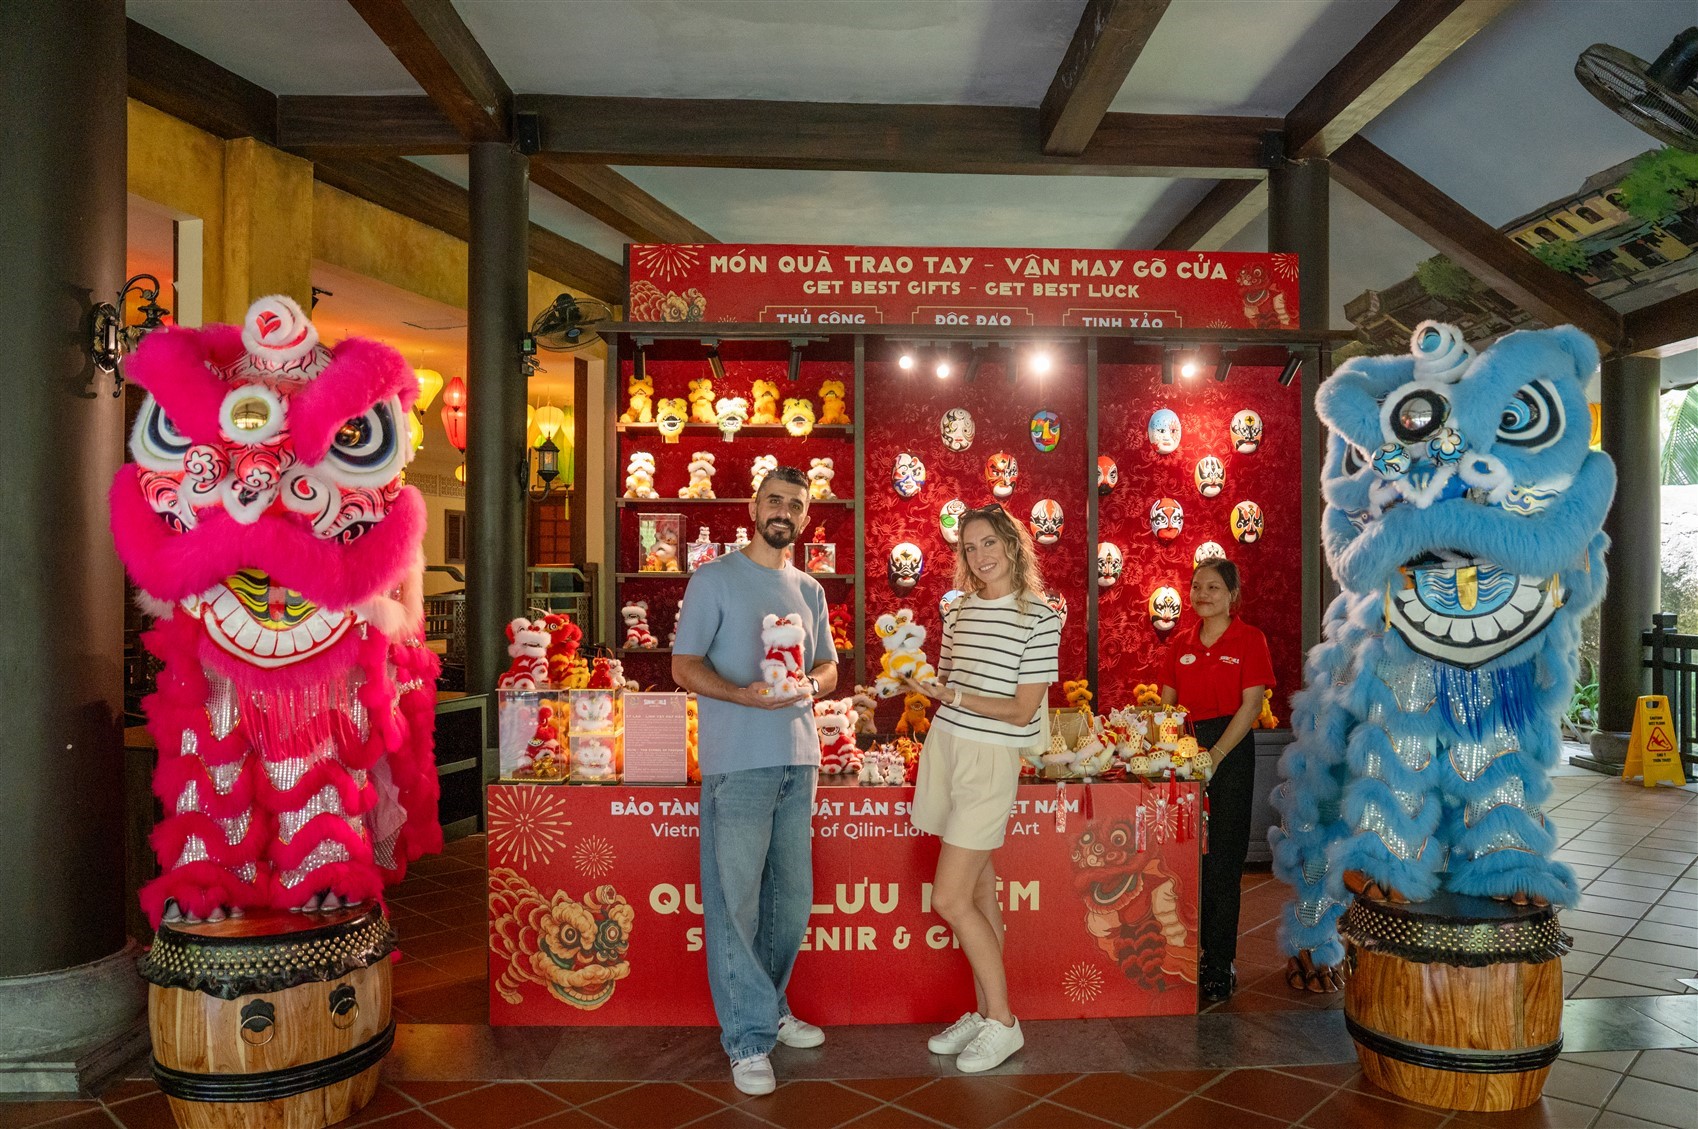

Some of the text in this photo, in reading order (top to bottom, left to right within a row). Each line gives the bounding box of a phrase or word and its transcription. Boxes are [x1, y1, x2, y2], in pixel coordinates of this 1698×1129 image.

[710, 248, 767, 273] MÓN
[778, 250, 833, 273] QUÀ
[844, 256, 913, 274] TRAO
[923, 256, 974, 274] TAY
[1071, 259, 1124, 277] MAY
[1133, 258, 1167, 278] GÕ
[1176, 253, 1228, 280] CỬA
[803, 280, 844, 294] GET
[851, 281, 900, 294] BEST
[907, 281, 961, 295] GIFTS
[985, 282, 1025, 296] GET
[1032, 283, 1081, 297] BEST
[1088, 283, 1140, 298] LUCK
[776, 308, 866, 324] THỦ CÔNG
[611, 796, 654, 816] BẢO
[659, 798, 699, 816] TÀN
[850, 798, 889, 816] LÂN
[651, 822, 700, 837] Vietn
[820, 822, 839, 837] of
[1011, 821, 1040, 835] Art
[649, 883, 704, 915] QU
[892, 925, 911, 950] &
